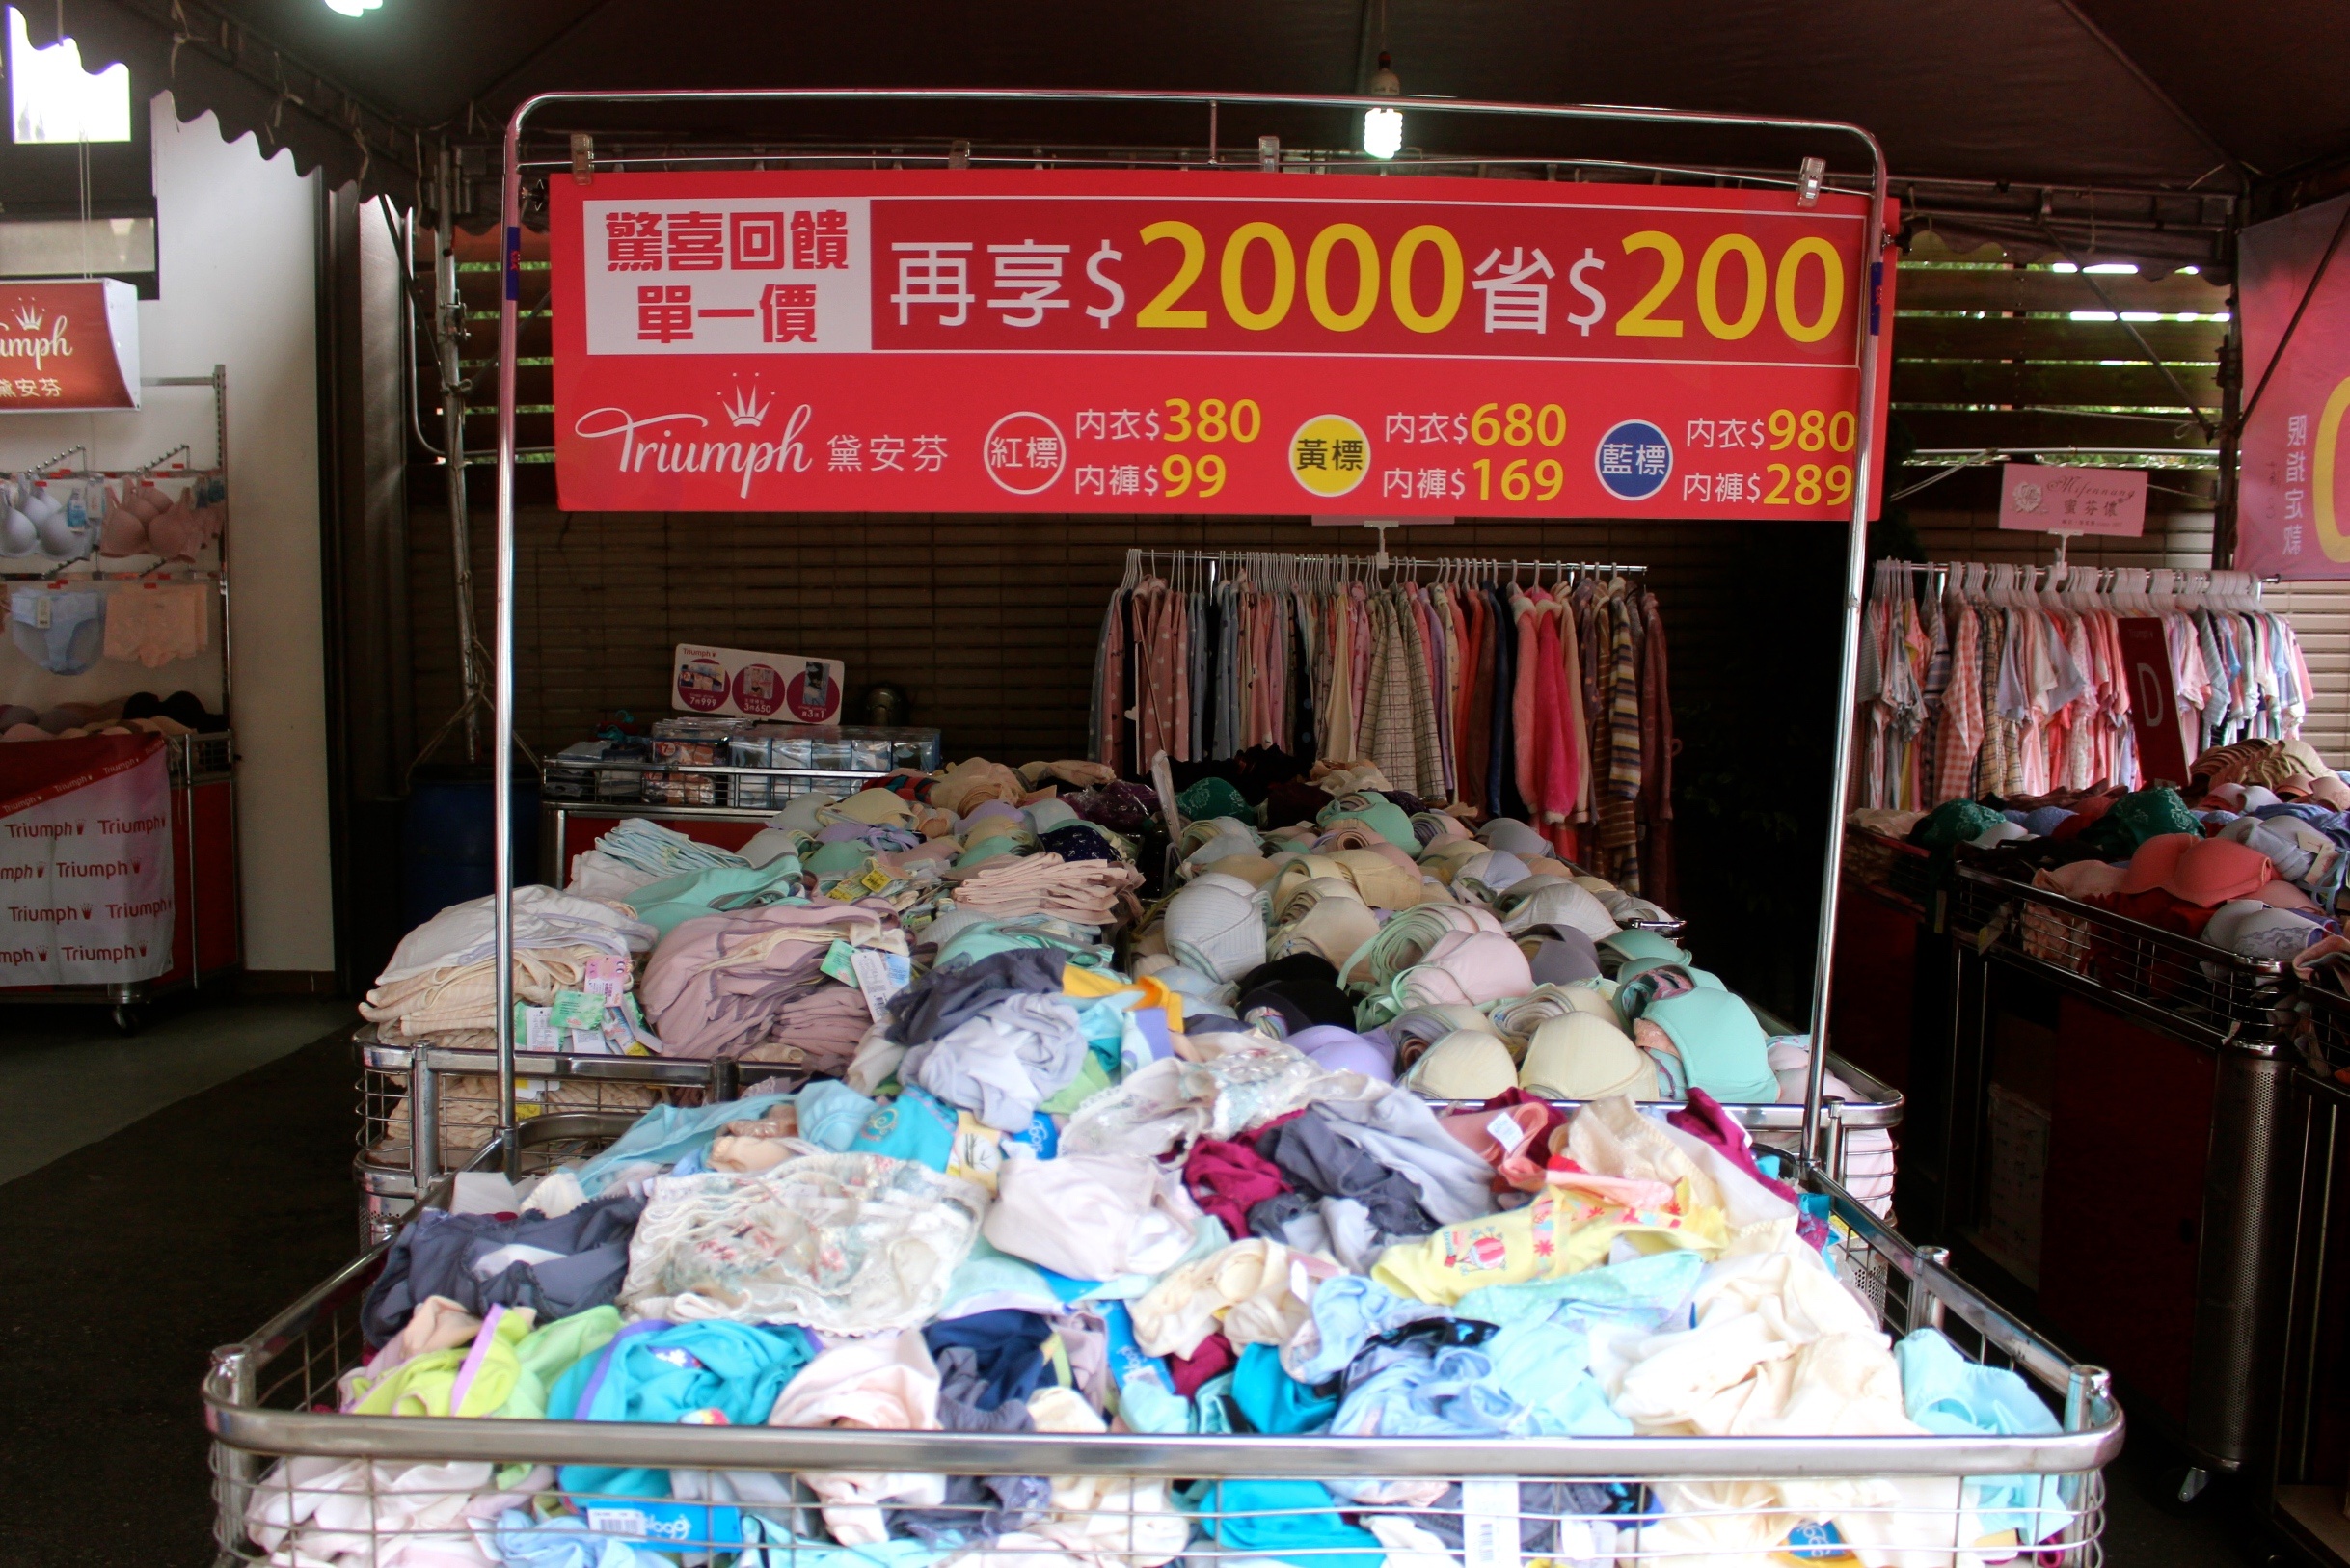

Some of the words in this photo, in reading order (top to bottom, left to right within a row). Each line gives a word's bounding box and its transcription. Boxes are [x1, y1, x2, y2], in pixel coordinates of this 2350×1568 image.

[606, 209, 849, 272] 驚喜回饋
[637, 284, 817, 343] 單一價
[575, 403, 812, 499] Triumph
[826, 435, 948, 473] 黛安芬
[991, 435, 1059, 469] 紅標
[1602, 443, 1666, 476] 藍標
[2136, 662, 2164, 727] D
[5, 822, 72, 840] Triumph
[97, 815, 161, 835] Triumph
[56, 861, 128, 879] Triumph
[8, 906, 78, 924] Triumph
[105, 898, 167, 919] Triumph
[62, 944, 136, 963] Triumph
